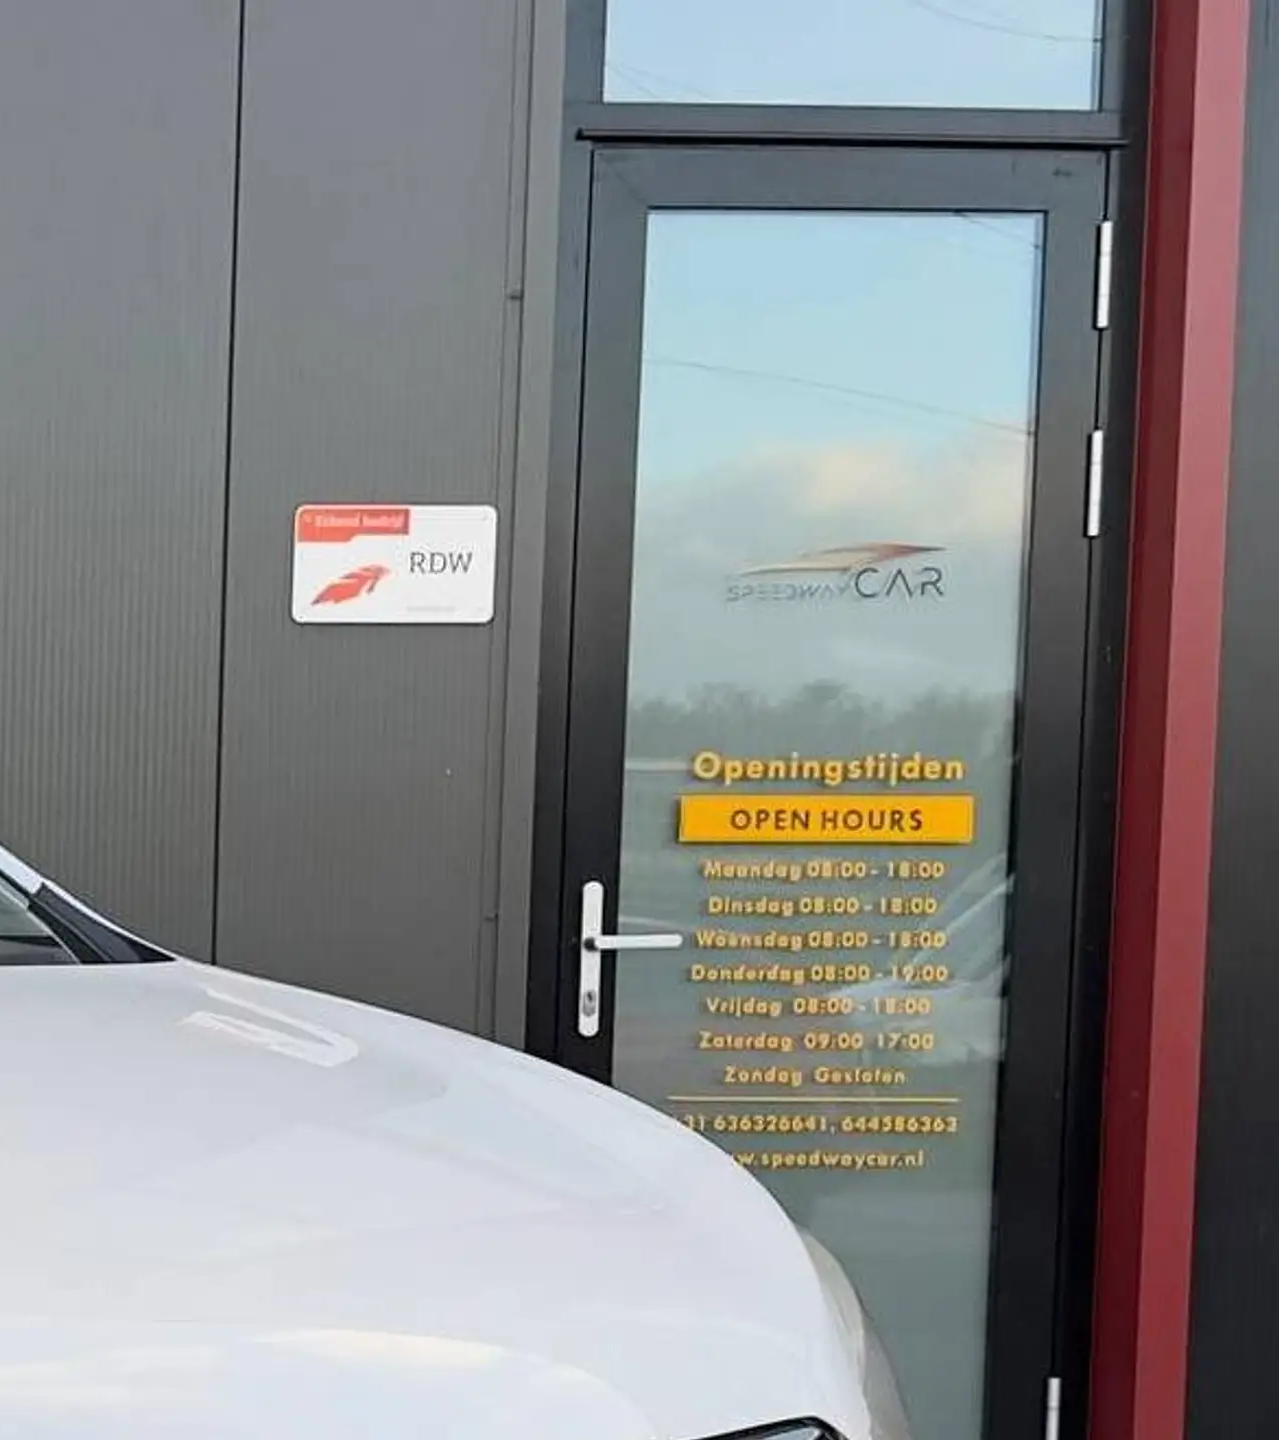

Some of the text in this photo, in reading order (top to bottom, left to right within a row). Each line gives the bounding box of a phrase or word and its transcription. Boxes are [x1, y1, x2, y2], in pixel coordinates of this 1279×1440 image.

[409, 552, 473, 574] RDW
[692, 751, 964, 784] Openingstijden
[730, 810, 923, 831] OPEN HOURS
[703, 861, 801, 880] Maandag
[807, 861, 866, 878] 08:00
[887, 861, 945, 878] 18:00
[709, 896, 794, 917] Dinsdag
[799, 897, 859, 914] 08:00
[880, 897, 937, 914] 18:00
[696, 931, 802, 951] Woensdag
[808, 931, 868, 948] 08:00
[888, 931, 947, 948] 18:00
[691, 964, 805, 985] Donderdag
[811, 965, 870, 982] 08:00
[892, 964, 949, 982] 19:00
[707, 997, 782, 1017] Vrijdag
[793, 997, 853, 1014] 08:00
[873, 997, 931, 1014] 18:00
[699, 1031, 934, 1052] Zaterdag 09:00 17:00
[724, 1066, 802, 1087] Zondag
